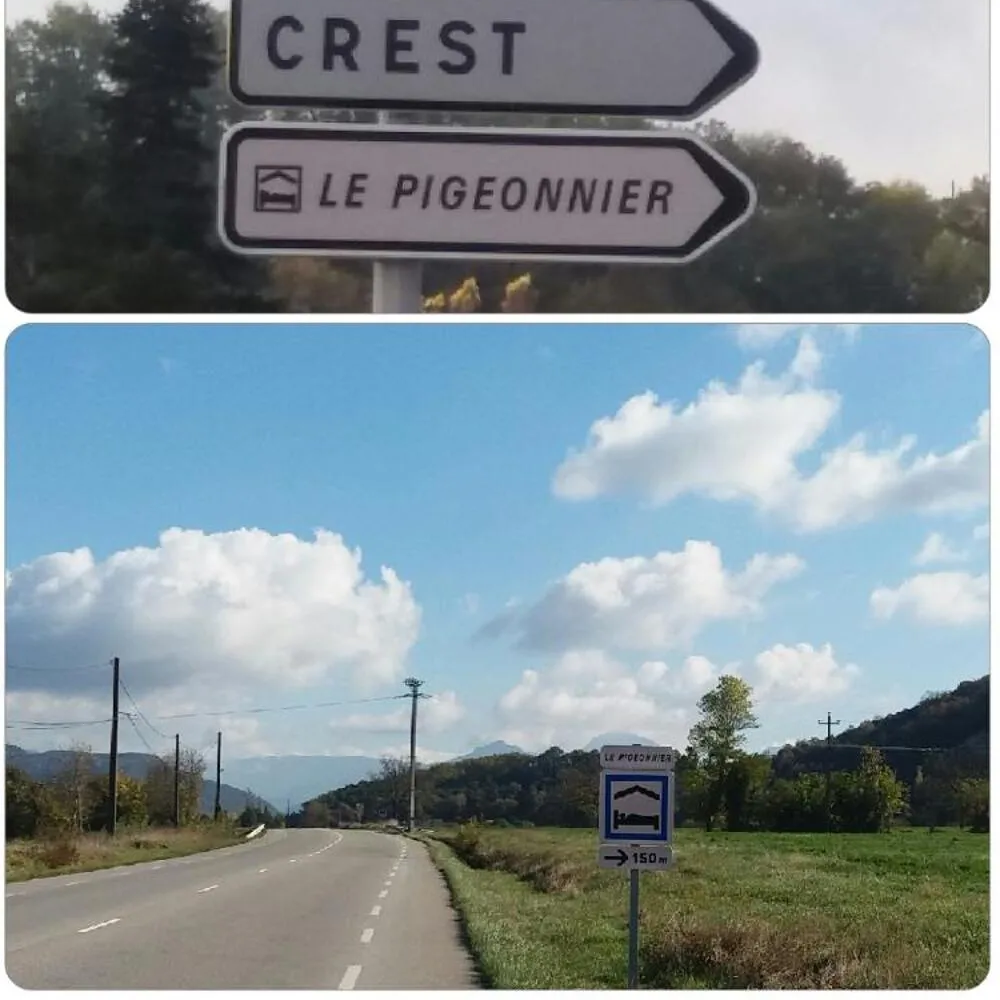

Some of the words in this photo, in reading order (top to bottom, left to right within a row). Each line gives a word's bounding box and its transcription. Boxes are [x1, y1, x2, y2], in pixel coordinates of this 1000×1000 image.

[266, 15, 527, 76] CREST
[319, 173, 368, 209] LE
[392, 174, 674, 216] PIGEONNIER
